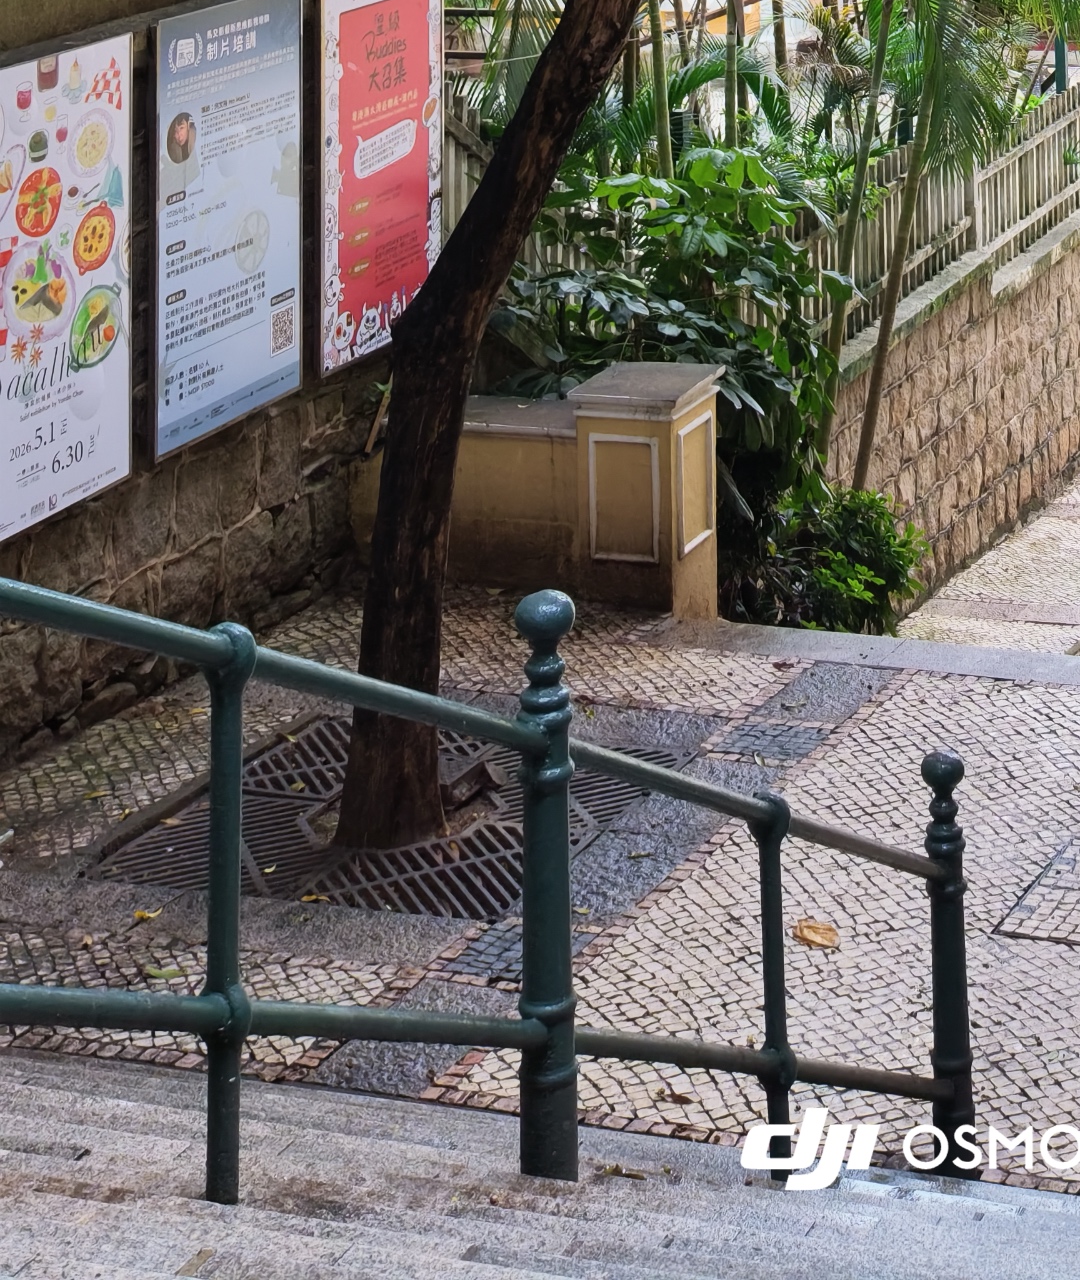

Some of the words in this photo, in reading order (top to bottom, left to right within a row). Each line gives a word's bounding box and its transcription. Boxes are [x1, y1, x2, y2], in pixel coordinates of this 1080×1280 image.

[206, 30, 257, 61] 制片培訓
[361, 31, 407, 63] Buddies
[368, 56, 407, 92] 大召集
[0, 324, 103, 401] acalhau
[51, 440, 84, 474] 6.30
